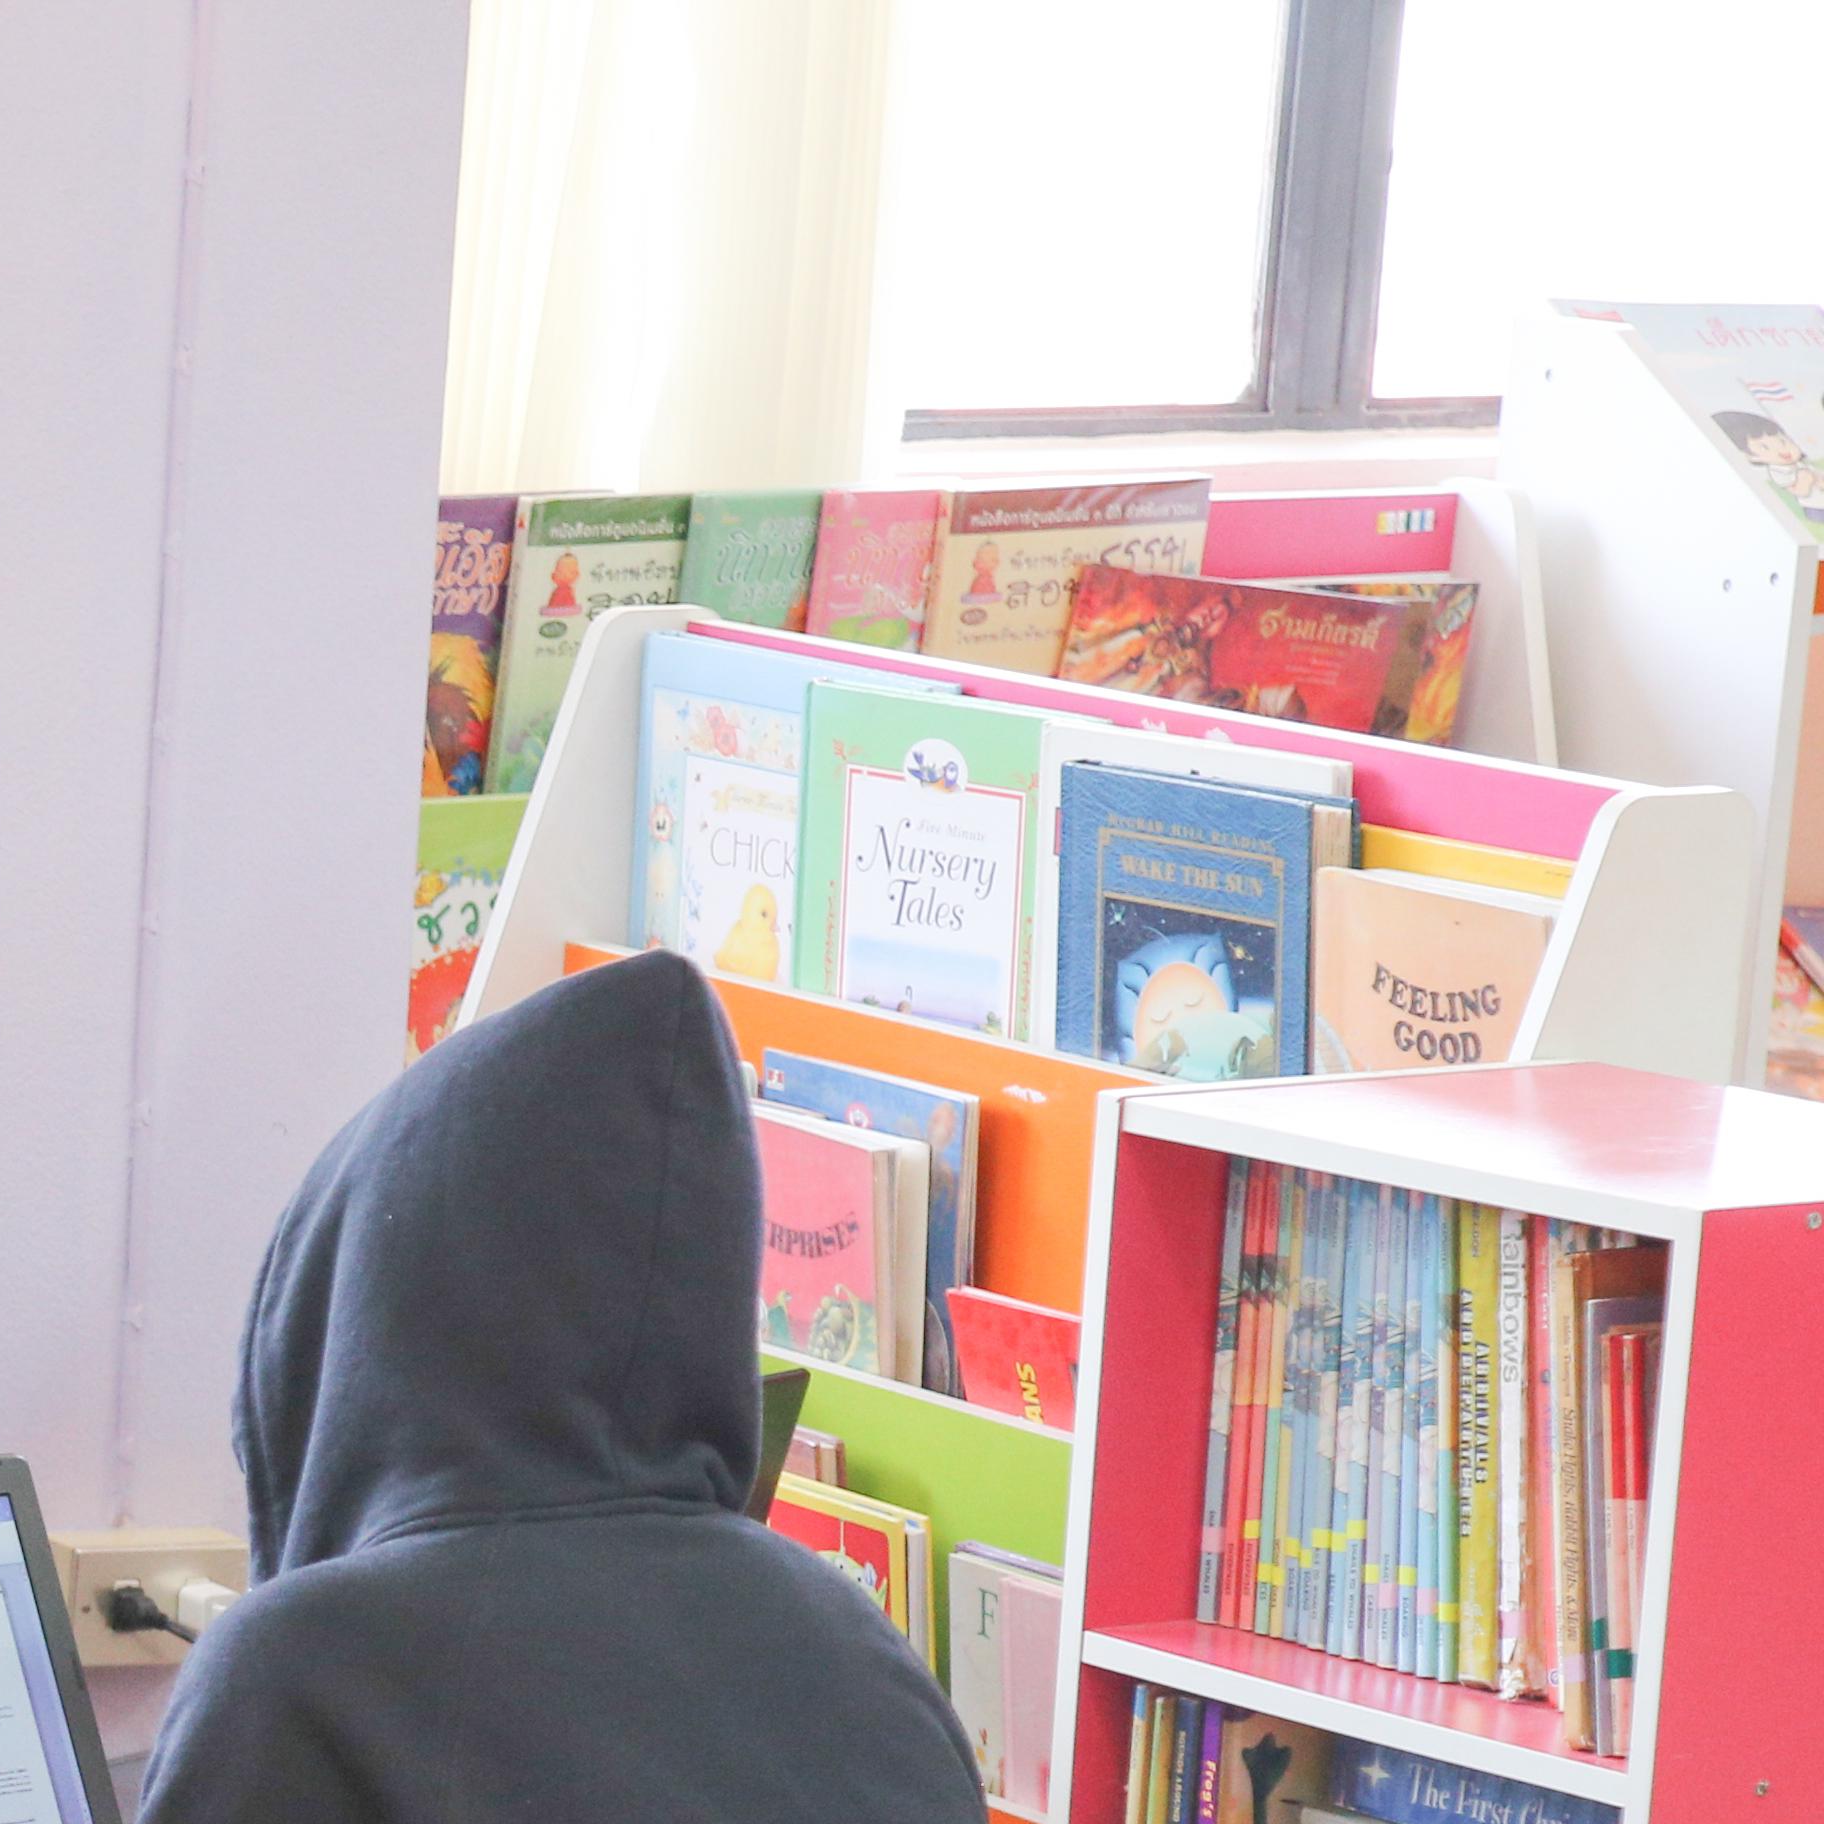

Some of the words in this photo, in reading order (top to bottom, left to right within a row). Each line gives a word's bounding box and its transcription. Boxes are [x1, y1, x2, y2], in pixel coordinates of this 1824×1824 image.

[856, 818, 997, 899] Nursery
[1120, 854, 1177, 882] WAKE
[1182, 865, 1220, 890] THE
[1226, 873, 1265, 897] SUN
[890, 879, 964, 932] Tales
[1371, 962, 1502, 1025] FEELING
[1392, 1019, 1483, 1064] GOOD
[766, 1210, 860, 1260] RPRISES
[1474, 1341, 1491, 1484] ARRIVALS
[1199, 1759, 1217, 1818] Frog's
[1409, 1762, 1451, 1811] The
